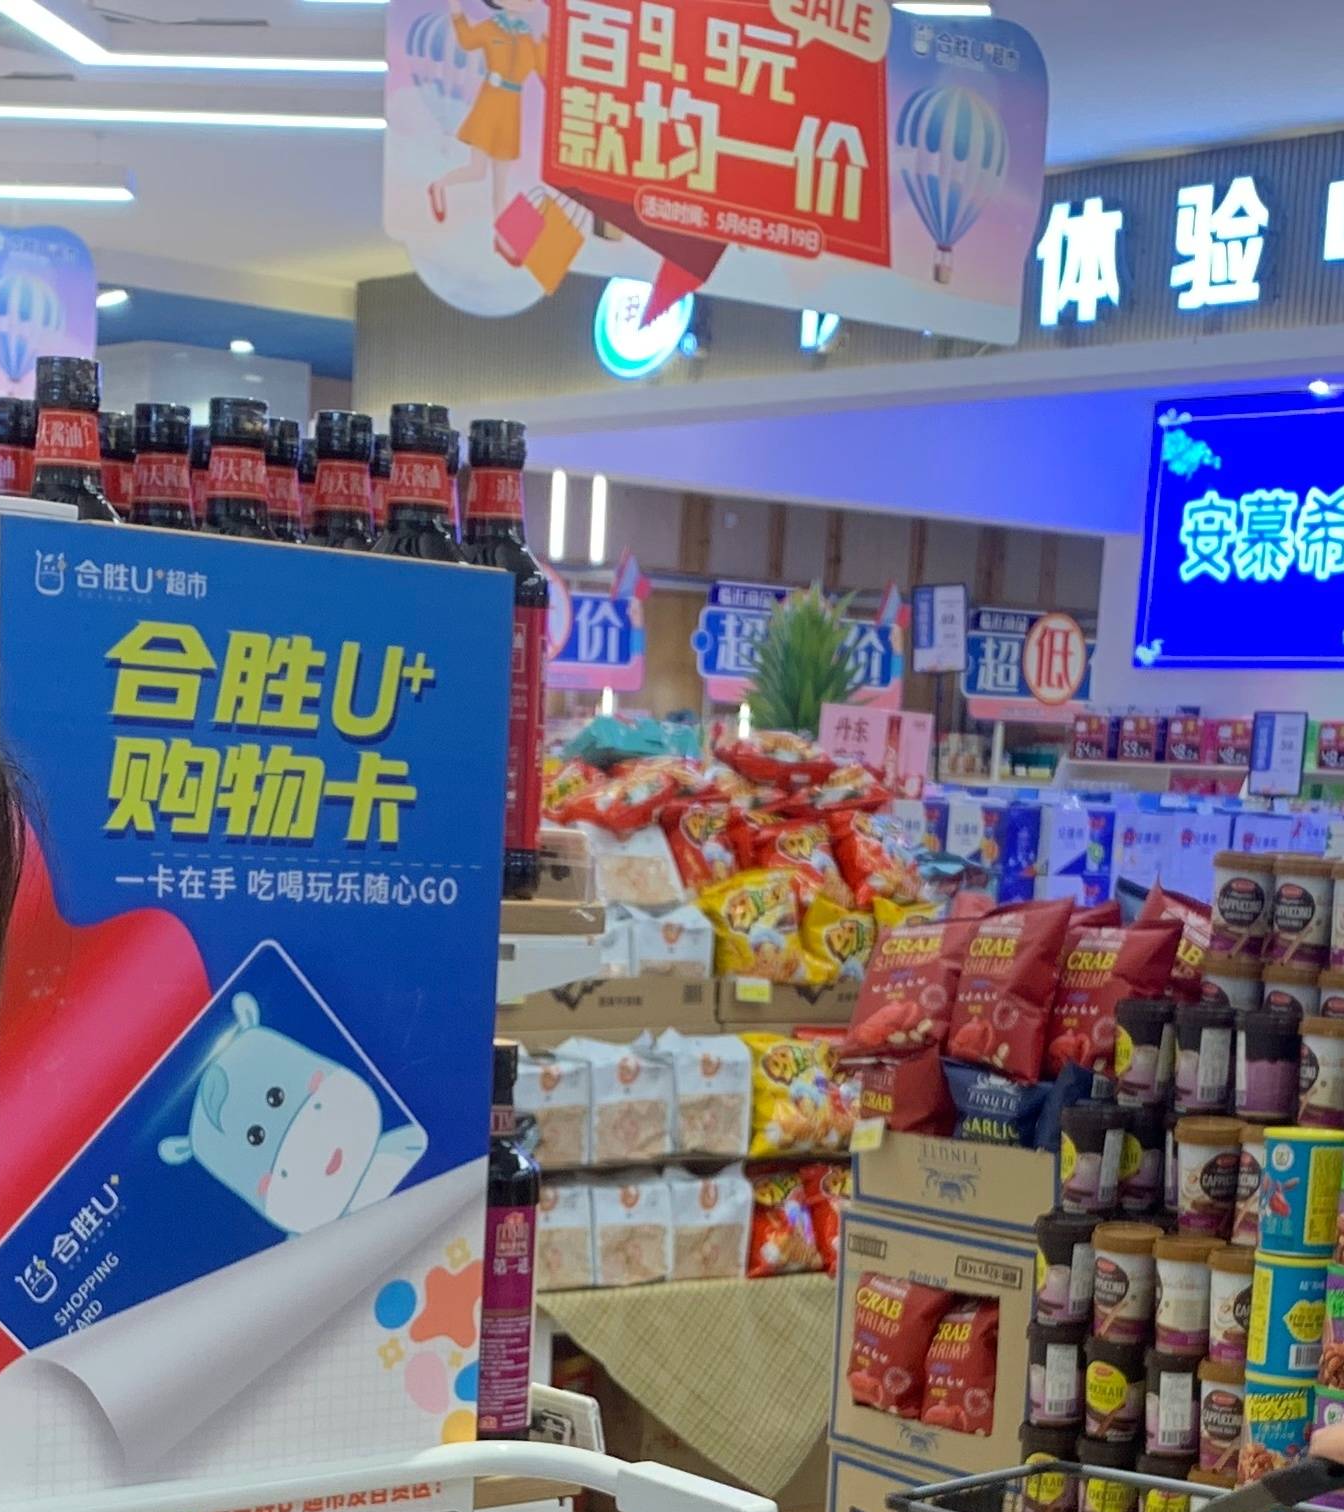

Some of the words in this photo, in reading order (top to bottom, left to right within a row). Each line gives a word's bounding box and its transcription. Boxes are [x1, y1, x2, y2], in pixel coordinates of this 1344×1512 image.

[557, 80, 870, 223] 款均一价
[103, 619, 435, 738] 合胜U+
[102, 736, 418, 844] 购物卡
[115, 866, 237, 902] 一卡在手
[247, 868, 458, 907] 吃喝玩乐随心GO
[882, 937, 942, 956] CRAB
[969, 937, 1017, 957] CRAB
[1067, 951, 1118, 972] CRAB
[53, 1251, 121, 1327] SHOPPING
[856, 1286, 903, 1321] CRAB
[856, 1308, 901, 1340] HRIMP
[926, 1342, 971, 1361] HRIMP
